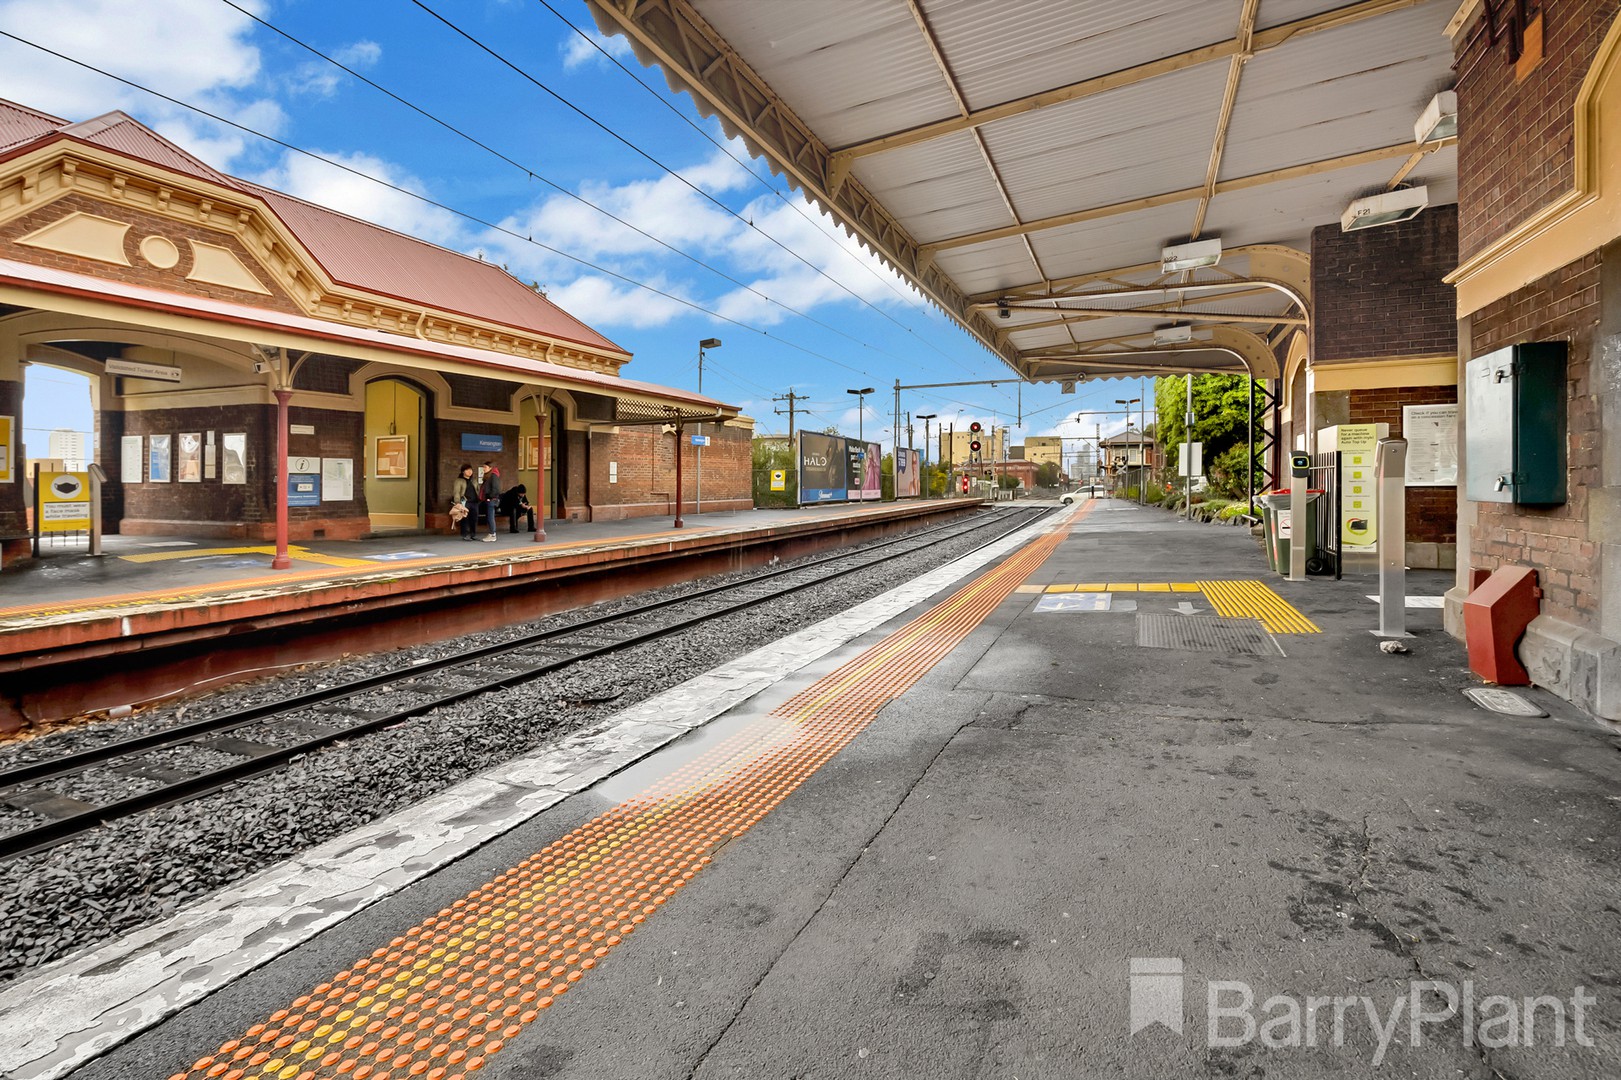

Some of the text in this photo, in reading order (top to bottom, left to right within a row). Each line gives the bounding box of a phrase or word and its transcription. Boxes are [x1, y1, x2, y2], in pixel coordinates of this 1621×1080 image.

[137, 366, 154, 374] Ticket
[1065, 381, 1073, 393] 2
[479, 439, 502, 447] Kensington
[803, 456, 827, 466] HALO
